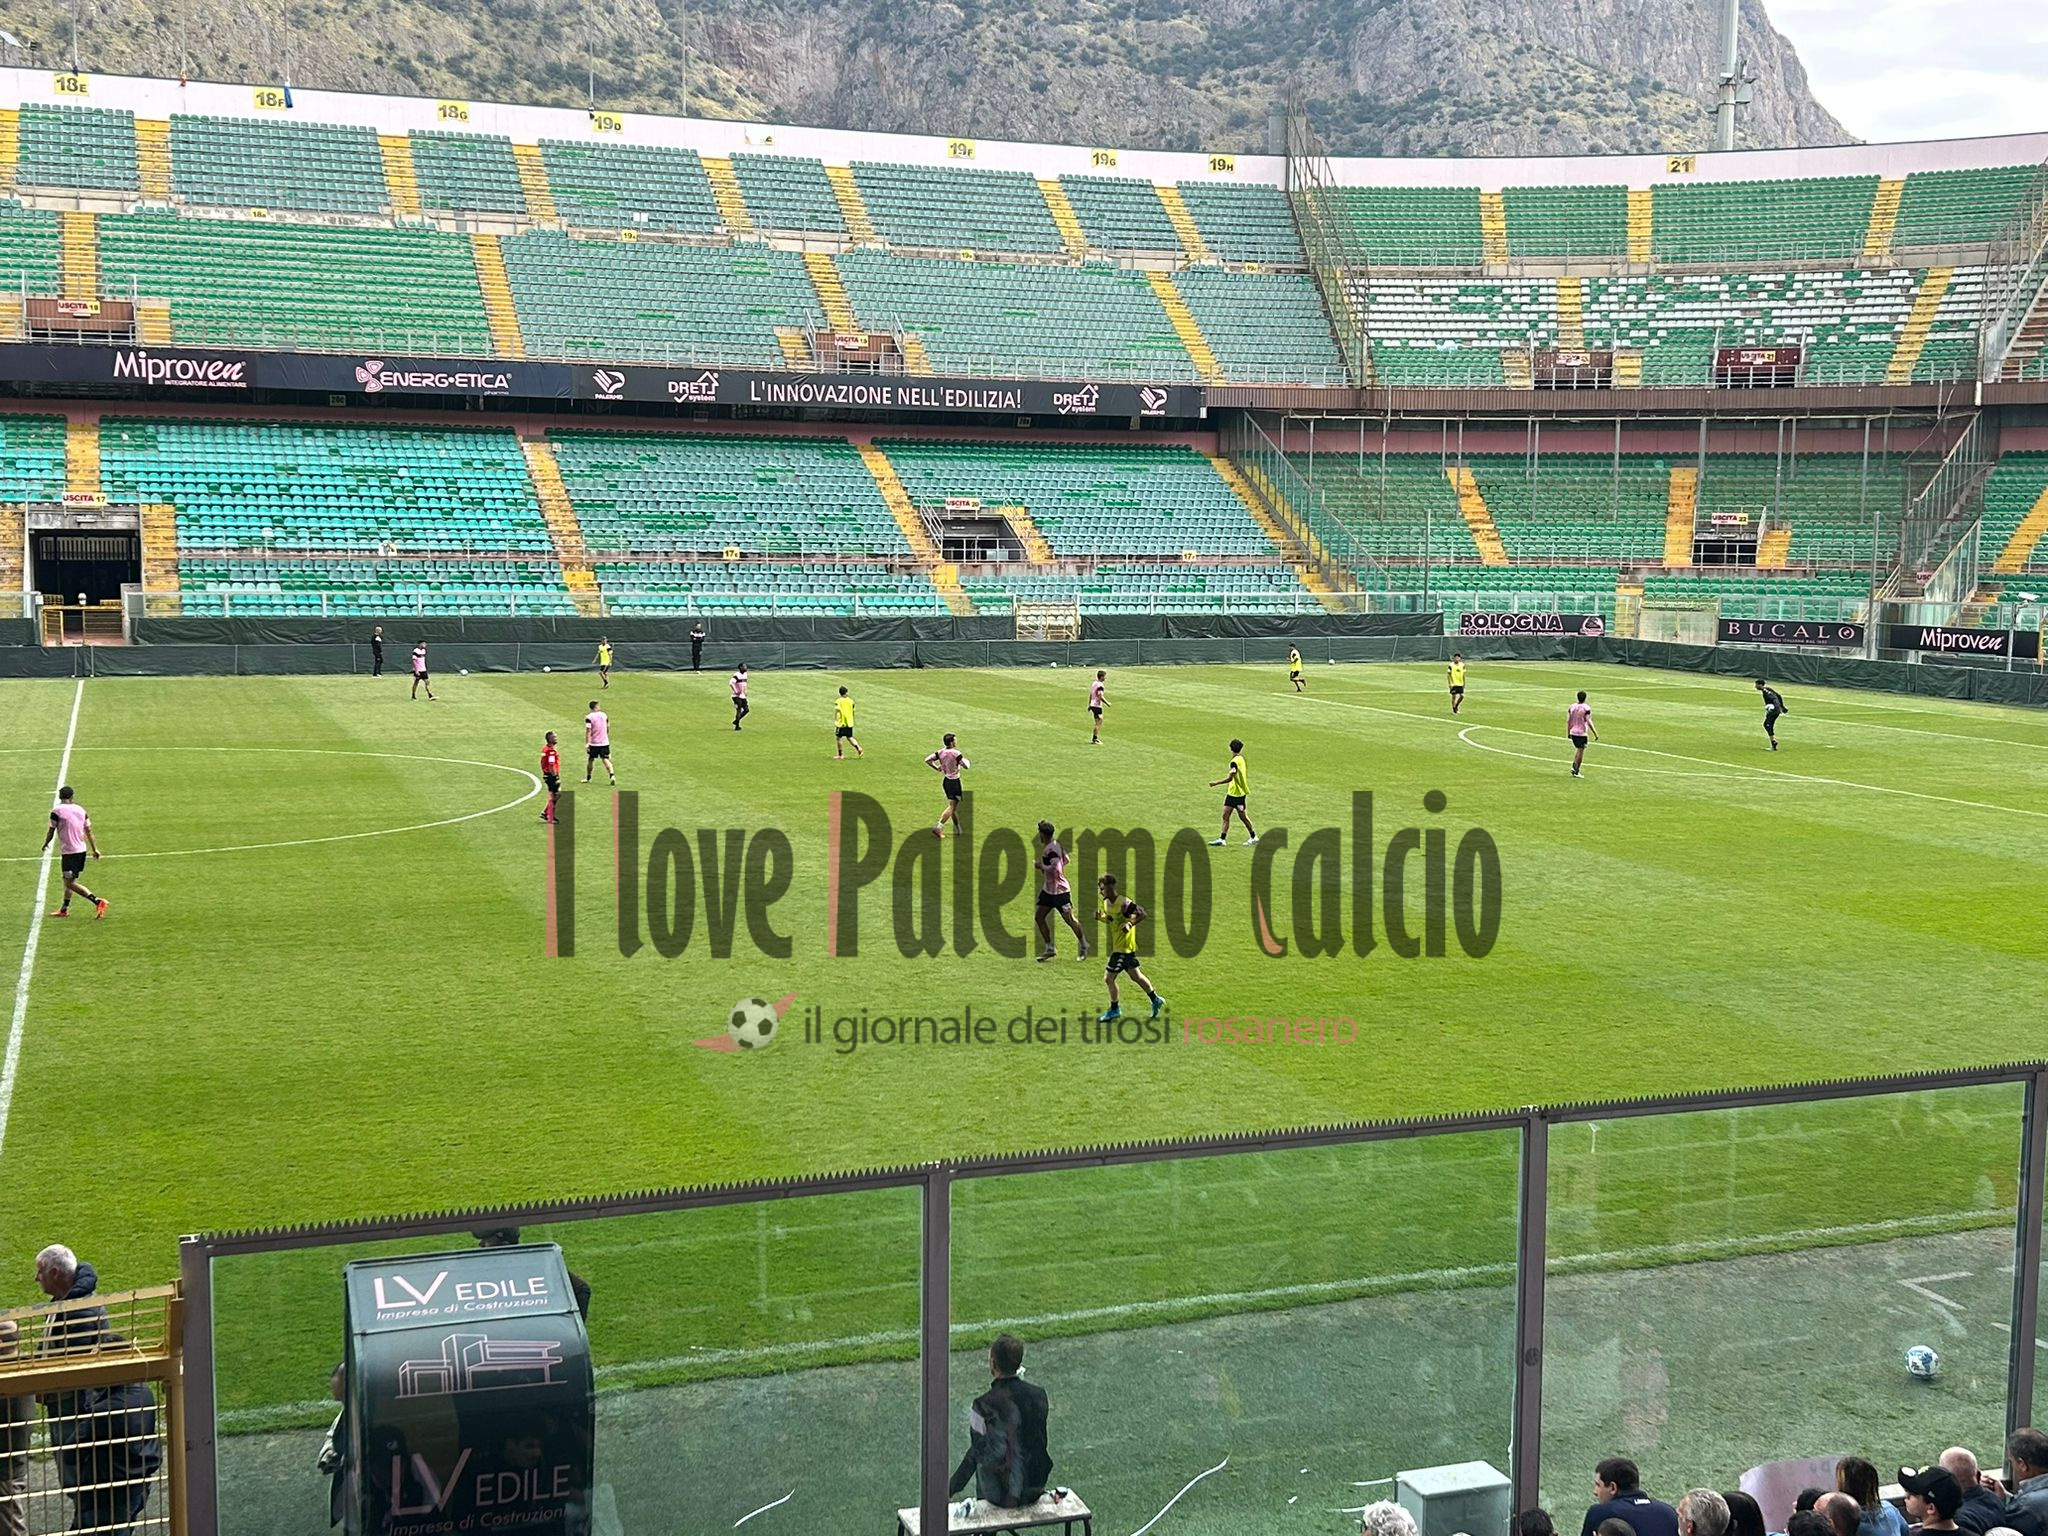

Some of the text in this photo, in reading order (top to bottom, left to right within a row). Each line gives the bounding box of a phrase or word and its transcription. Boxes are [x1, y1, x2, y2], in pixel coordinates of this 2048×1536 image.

[1209, 158, 1234, 171] 19H
[1670, 160, 1690, 173] 21
[750, 380, 1021, 408] L'INNOVAZIONE NELL'EDILIZIA!
[63, 494, 94, 502] USCITA
[1459, 613, 1564, 631] BOLOGNA
[1919, 628, 2003, 651] Miproven
[374, 1271, 548, 1310] LV EDILE
[376, 1296, 548, 1321] Impresa di Costruzioni
[391, 1447, 571, 1516] LV EDILE
[389, 1506, 568, 1536] Impresa di Costruzioni
